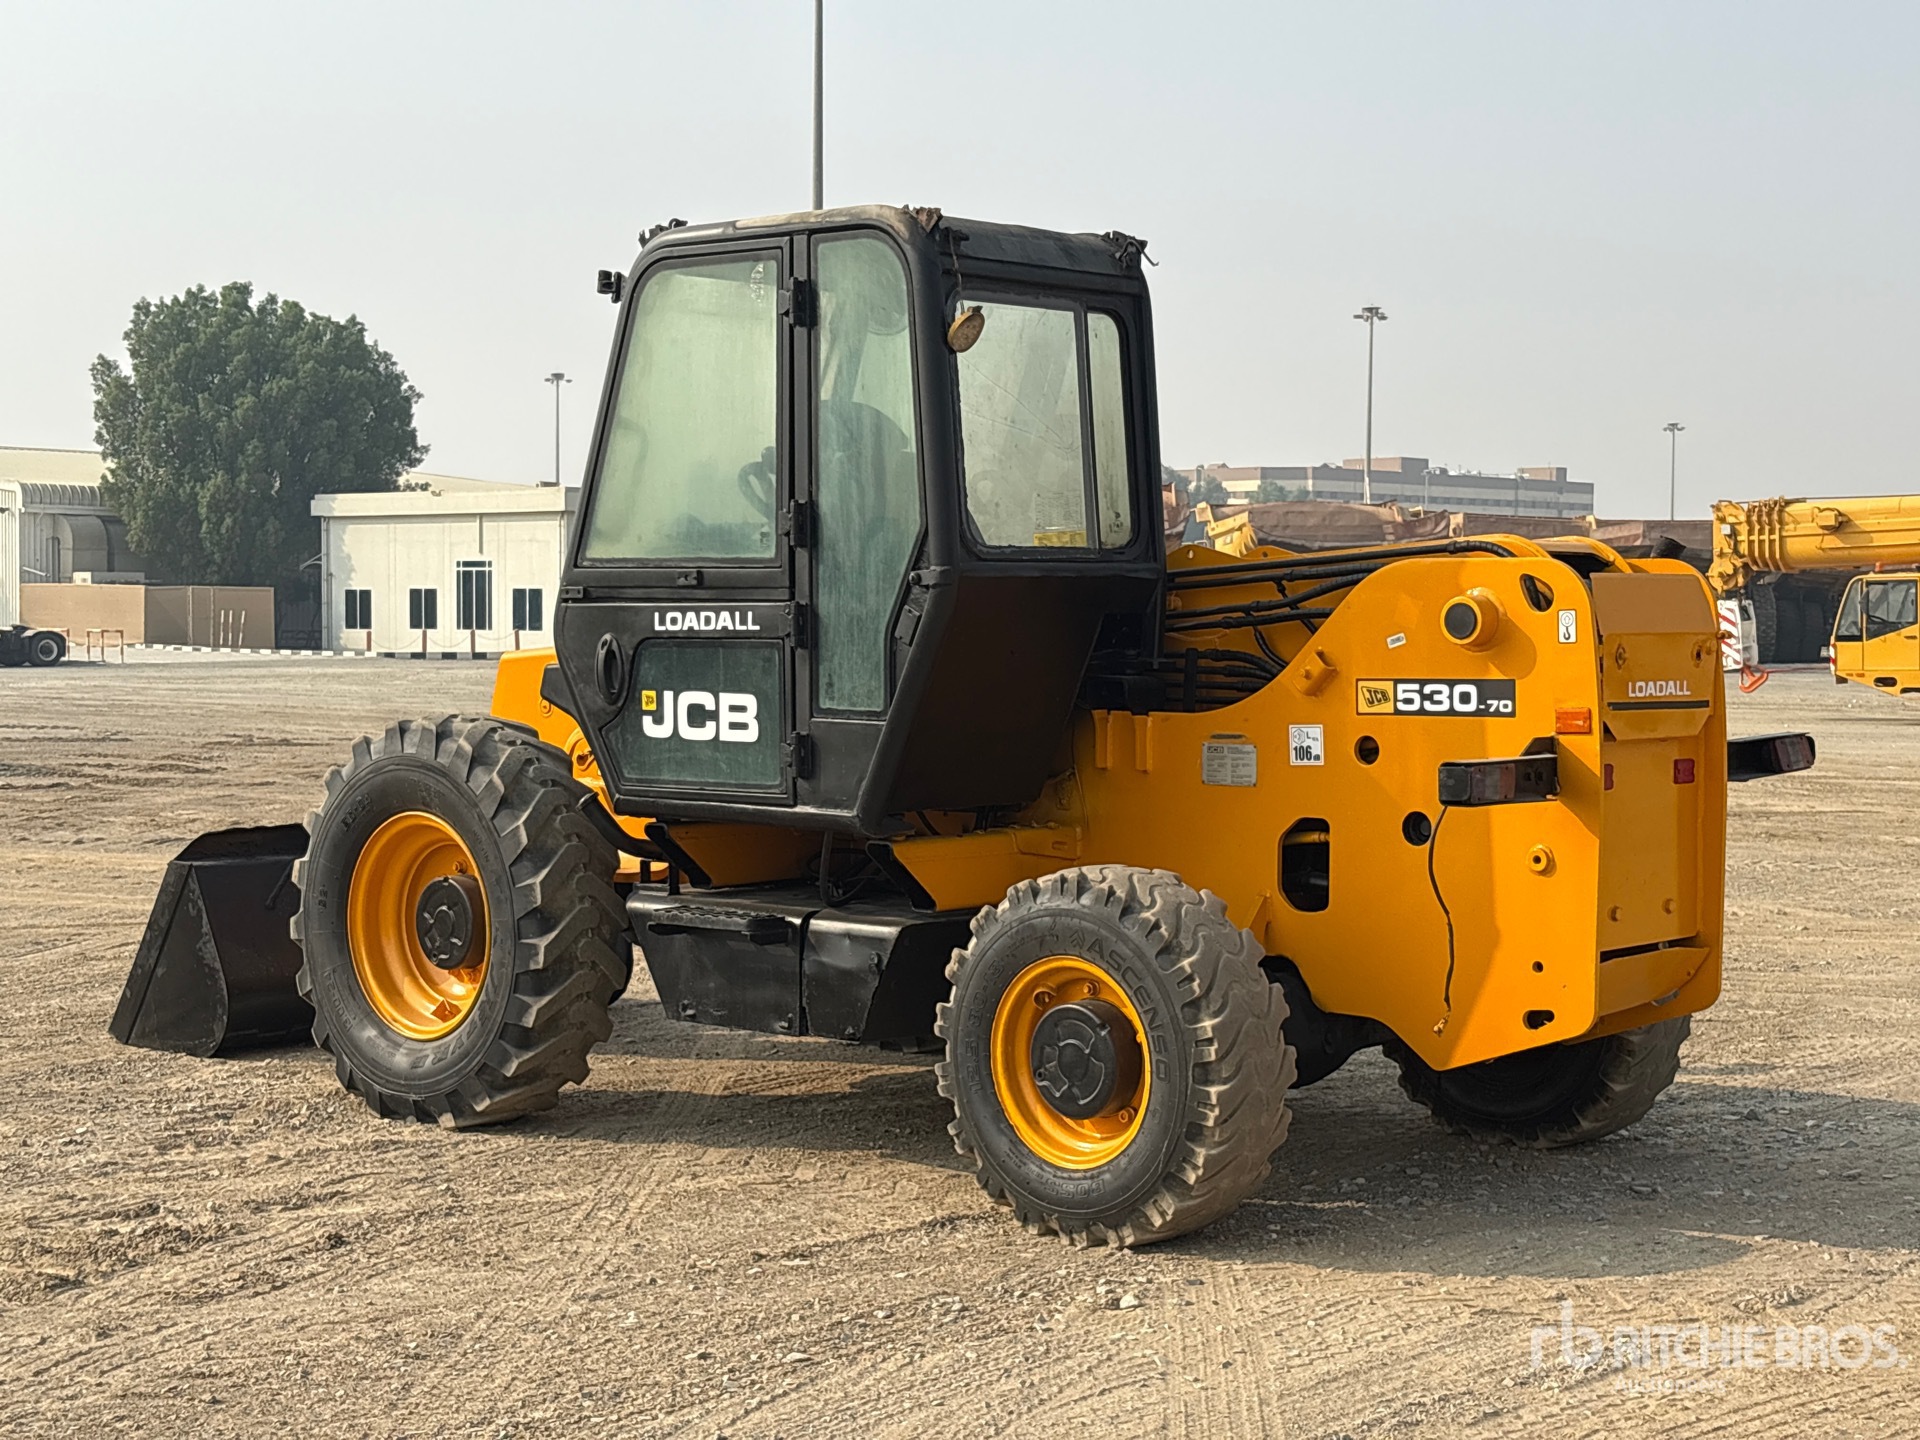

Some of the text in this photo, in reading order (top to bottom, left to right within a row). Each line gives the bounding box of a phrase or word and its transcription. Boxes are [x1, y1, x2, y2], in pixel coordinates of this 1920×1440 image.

[654, 611, 760, 631] LOADALL
[1366, 683, 1512, 712] JCB 530-70
[1628, 680, 1691, 697] LOADALL
[642, 690, 759, 743] JCB
[1293, 745, 1313, 761] 106
[1086, 937, 1170, 1084] ASCENSO
